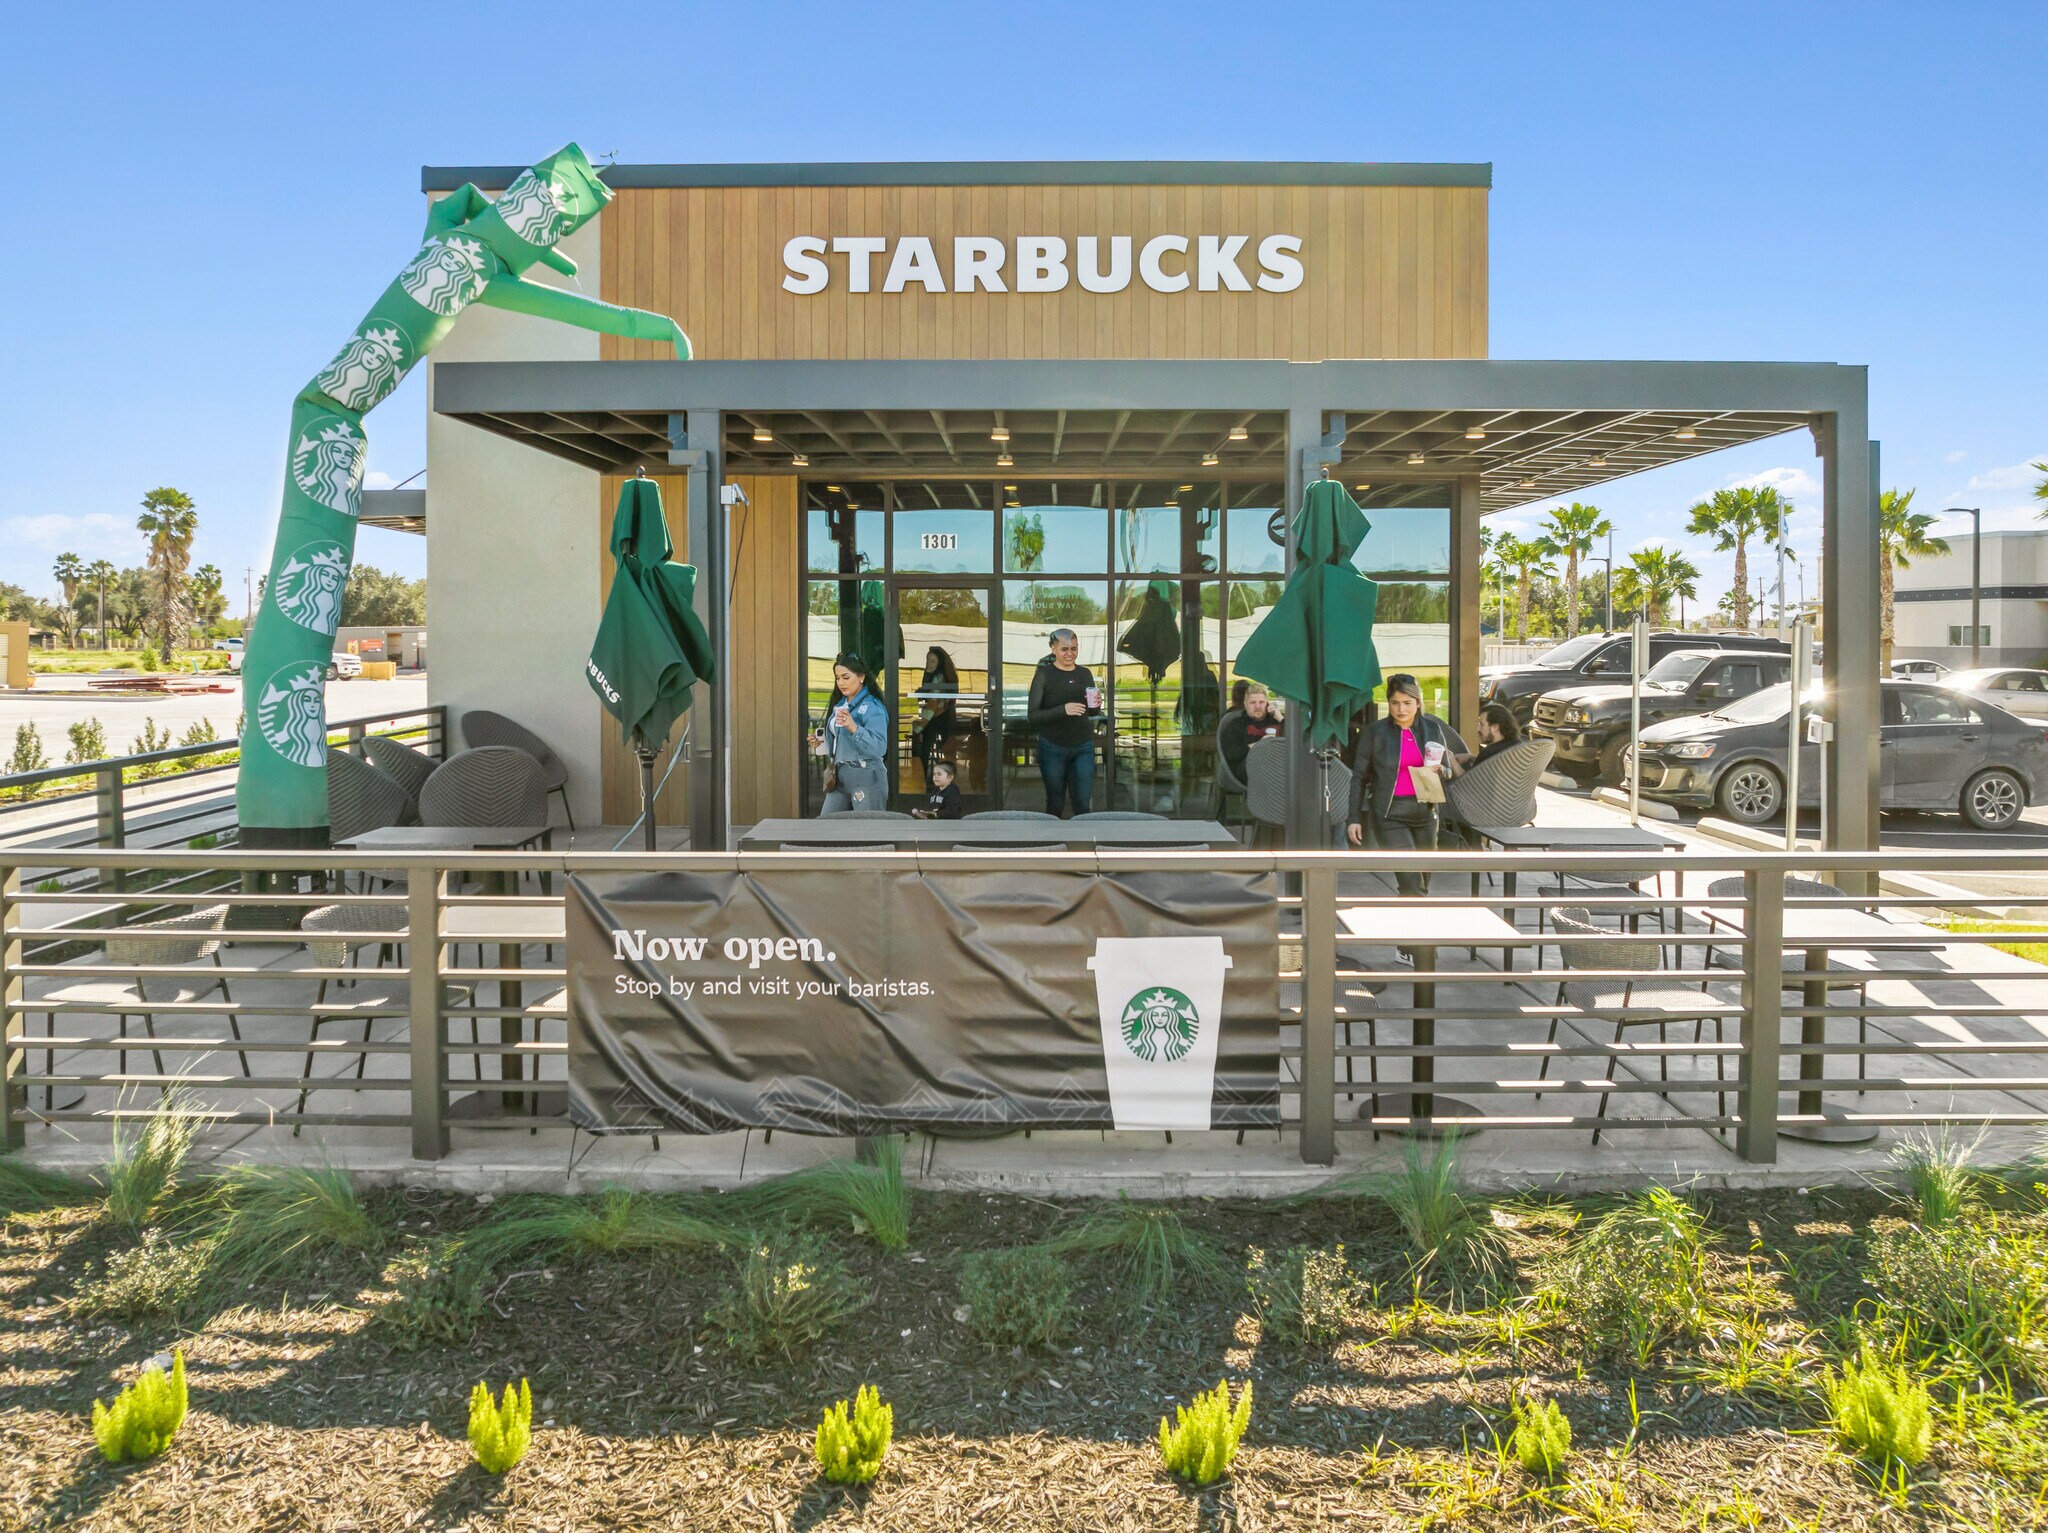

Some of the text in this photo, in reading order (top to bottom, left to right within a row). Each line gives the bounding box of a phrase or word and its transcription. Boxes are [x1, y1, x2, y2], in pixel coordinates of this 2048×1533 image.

[782, 235, 1305, 294] STARBUCKS
[923, 534, 956, 549] 1301
[611, 929, 837, 969] Now open.
[614, 974, 935, 1001] Stop by and visit your baristas.
